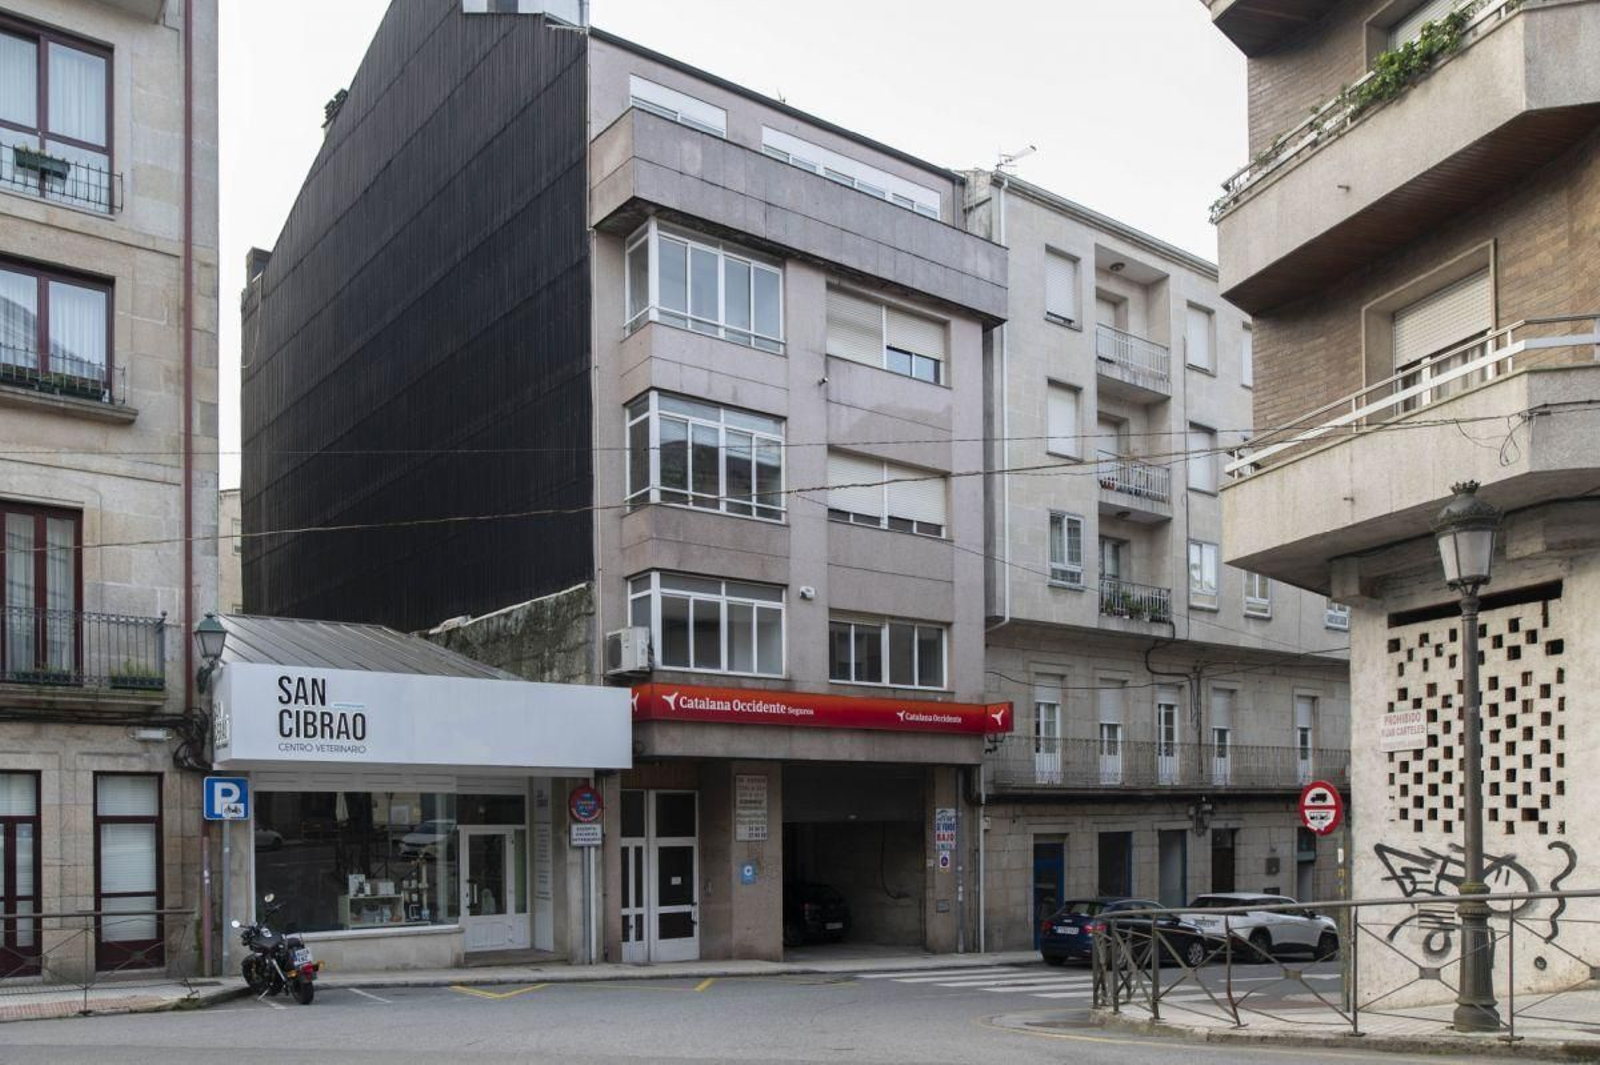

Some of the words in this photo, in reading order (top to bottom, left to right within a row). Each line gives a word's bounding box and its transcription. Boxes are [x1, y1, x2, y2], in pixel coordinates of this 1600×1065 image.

[278, 675, 326, 706] SAN
[679, 696, 731, 711] Catalana
[732, 699, 787, 714] Occidente
[787, 707, 814, 717] Seguros
[278, 709, 366, 741] CIBRAO
[905, 712, 932, 722] Catalana
[933, 714, 962, 723] Occidente
[1384, 712, 1420, 725] PROHIBIDO
[1397, 725, 1425, 736] CARTELES
[278, 742, 314, 753] CENTRO
[315, 743, 367, 755] VETERINARIO
[214, 782, 240, 814] P
